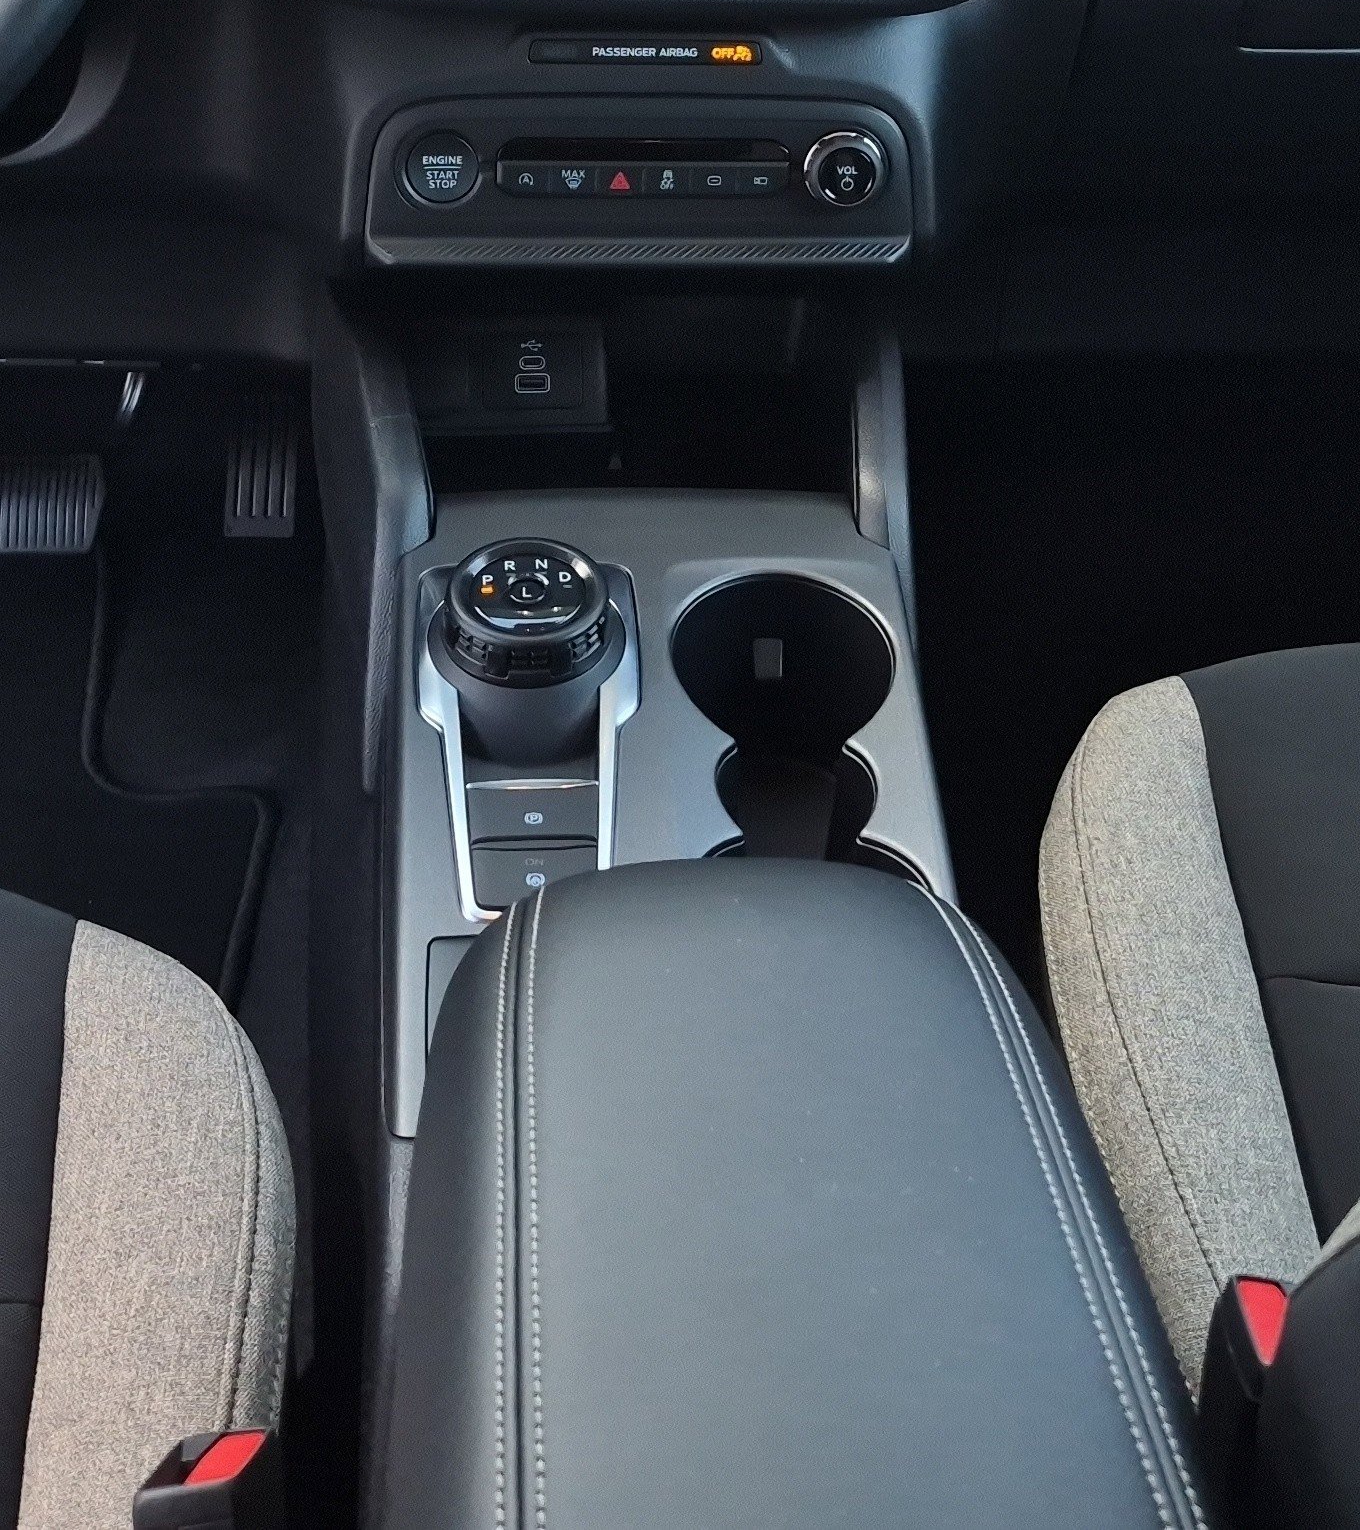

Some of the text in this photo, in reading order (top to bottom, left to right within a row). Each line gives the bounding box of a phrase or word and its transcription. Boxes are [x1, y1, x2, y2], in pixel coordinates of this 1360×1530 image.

[592, 46, 735, 59] PASSENGER AIRBAG OFF
[422, 156, 463, 165] ENGINE
[426, 170, 459, 180] START
[561, 169, 586, 178] MAX
[836, 165, 858, 175] VOL
[429, 179, 457, 189] STOP
[504, 560, 516, 571] R
[535, 558, 548, 569] N
[482, 574, 494, 586] P
[558, 571, 572, 583] D
[522, 586, 533, 598] L
